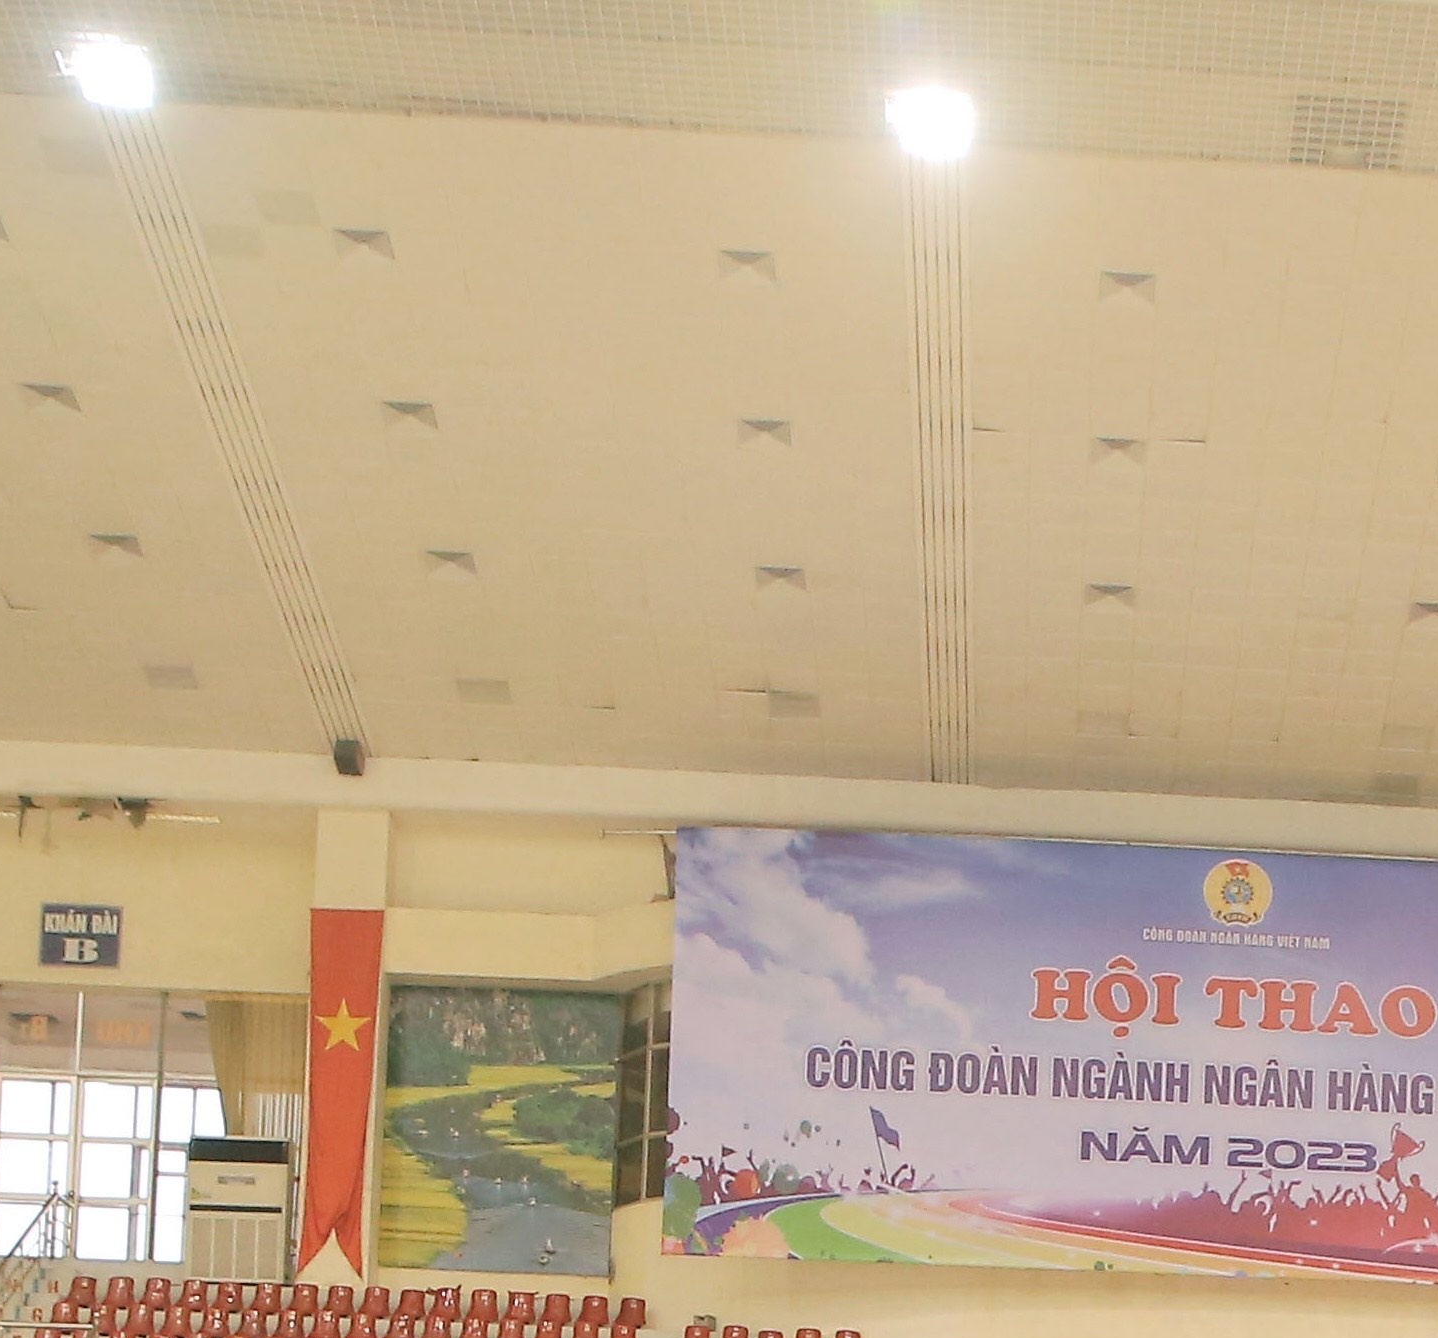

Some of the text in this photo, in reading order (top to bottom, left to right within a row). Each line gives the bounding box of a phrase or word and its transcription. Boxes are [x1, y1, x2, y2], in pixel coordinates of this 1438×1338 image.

[62, 937, 99, 963] B
[1029, 955, 1438, 1040] HỘI THAO
[805, 1038, 915, 1092] CÔNG
[928, 1041, 1035, 1097] ĐOÀN
[1051, 1044, 1190, 1102] NGÀNH
[1202, 1056, 1315, 1109] NGÂN
[1326, 1061, 1435, 1115] HÀNG
[1080, 1123, 1379, 1174] NĂM 2023
